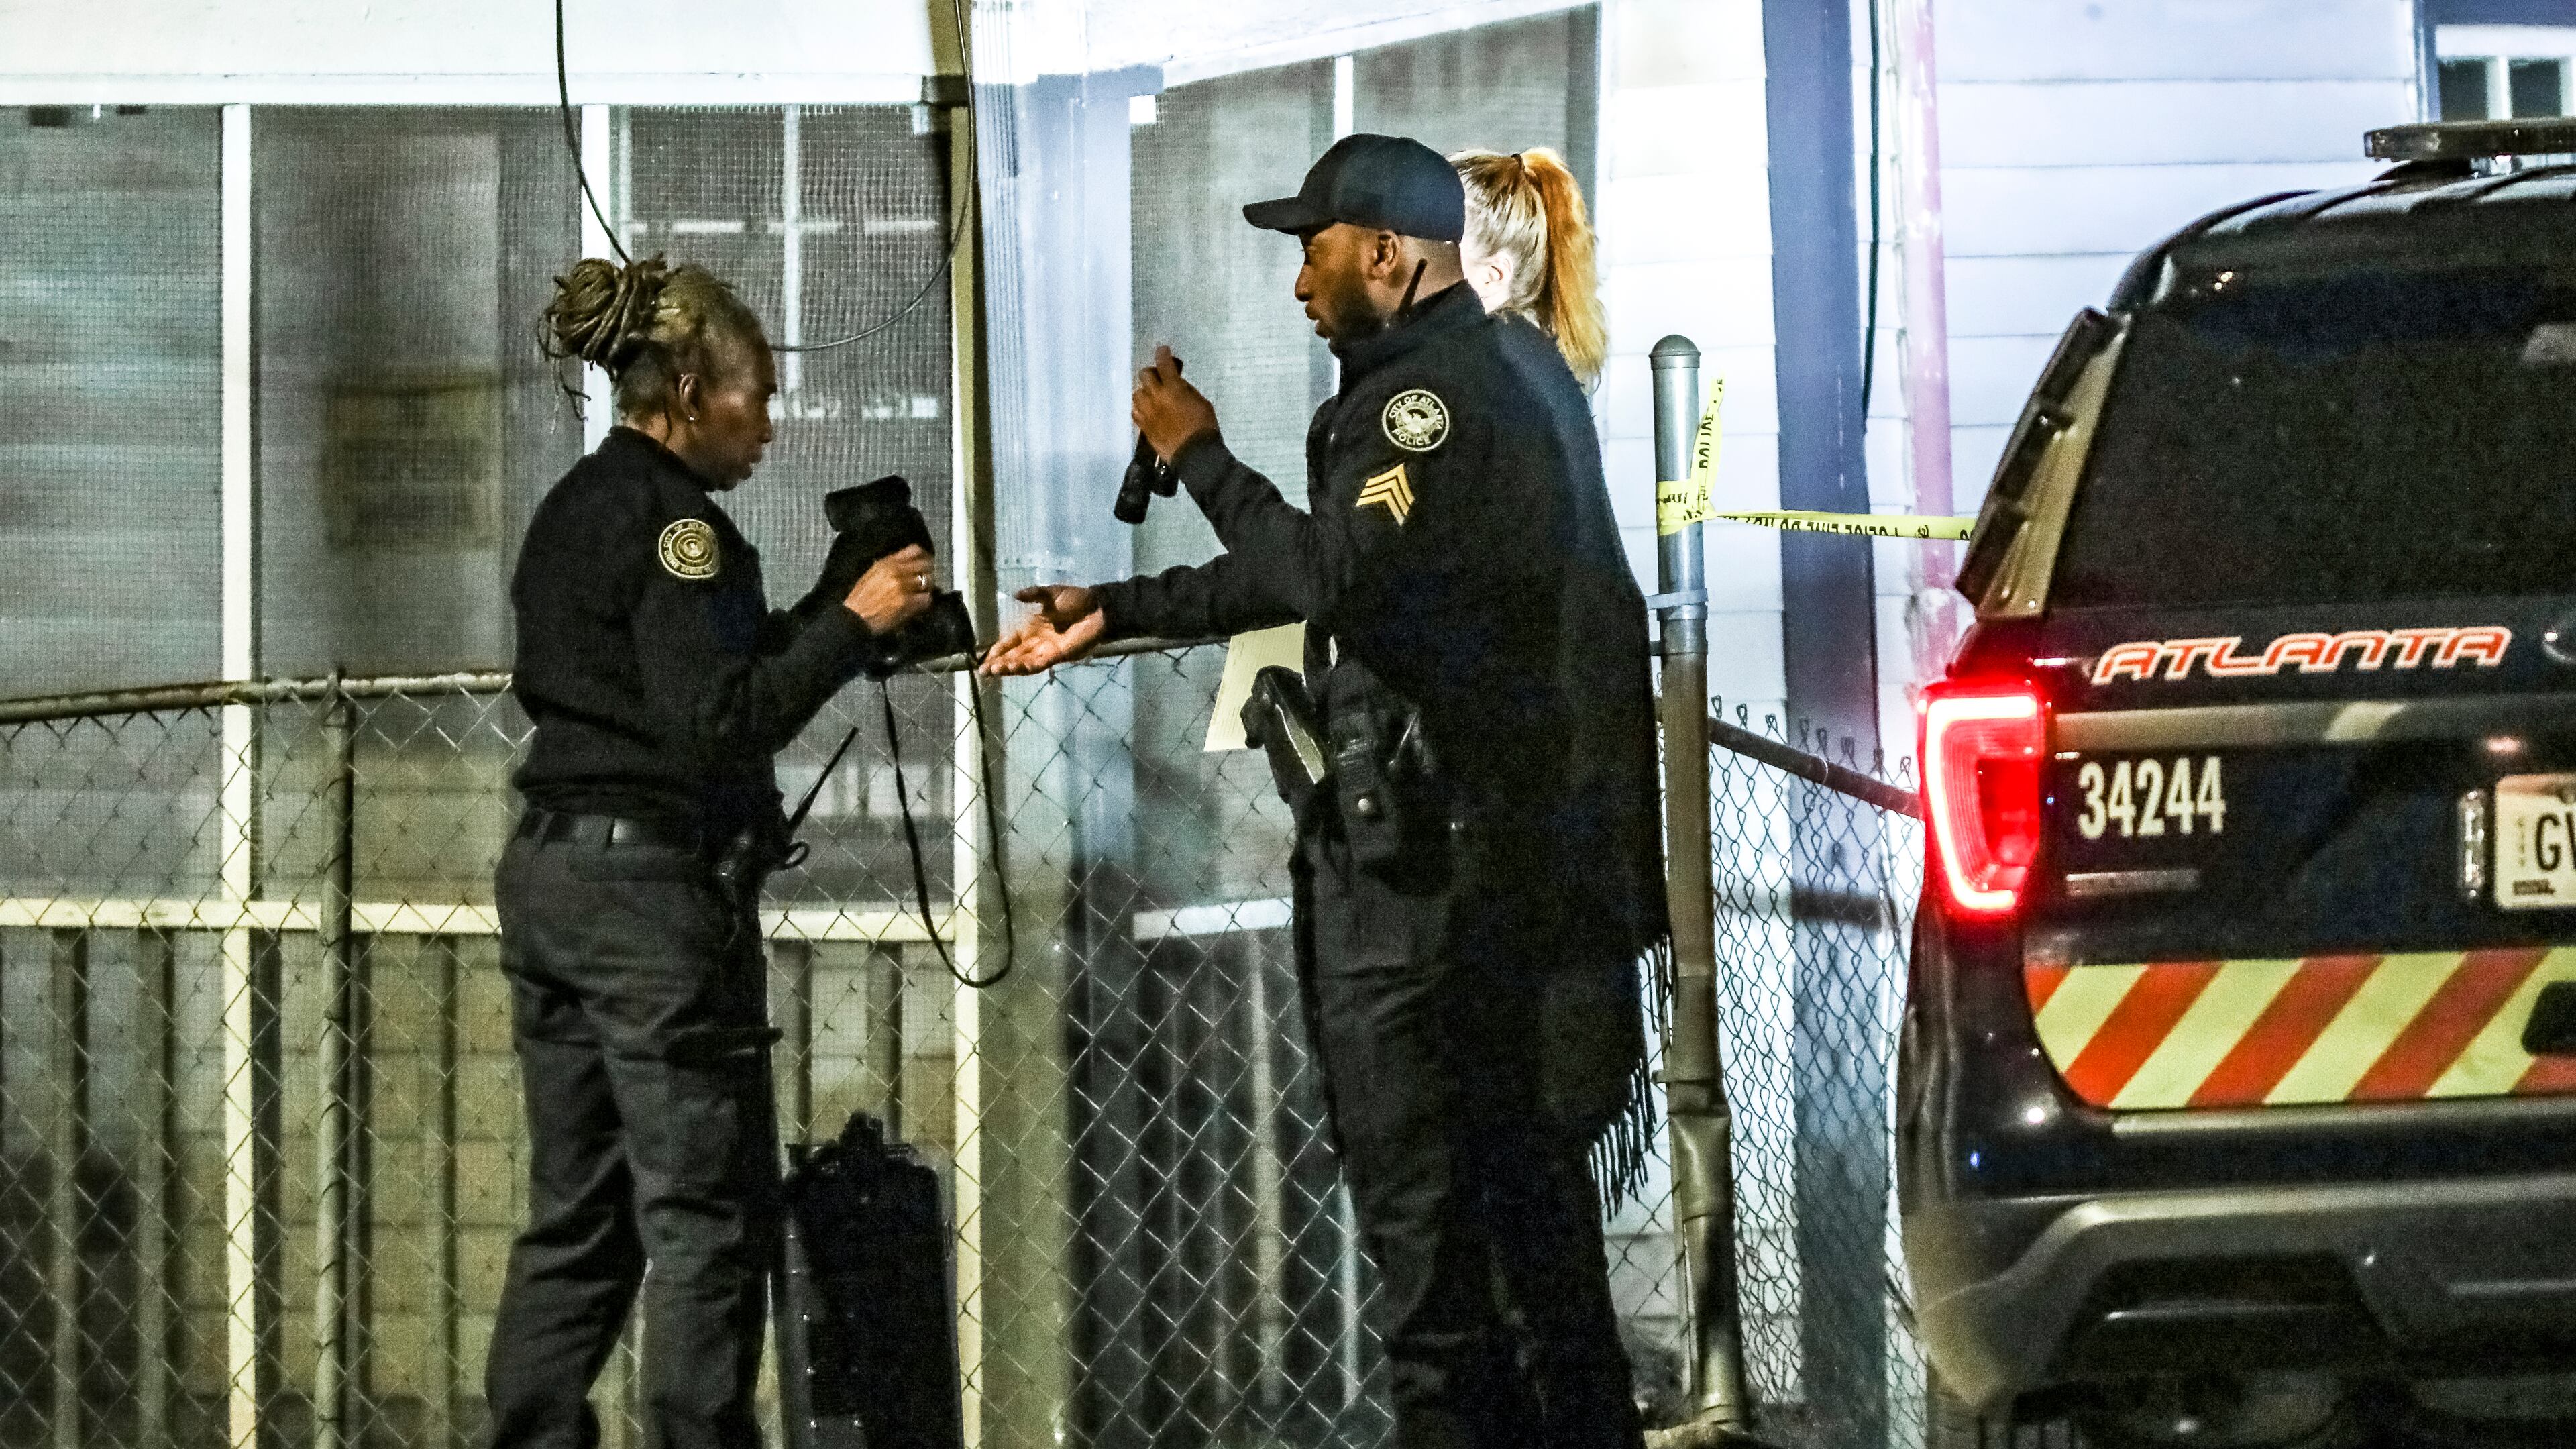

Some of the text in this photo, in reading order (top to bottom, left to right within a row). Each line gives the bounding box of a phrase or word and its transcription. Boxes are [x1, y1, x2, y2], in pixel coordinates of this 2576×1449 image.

[1389, 394, 1443, 430] CITY OF ATLANTA
[1391, 428, 1432, 446] POLICE
[2092, 625, 2512, 686] ATLANTA
[2078, 755, 2227, 839] 34244
